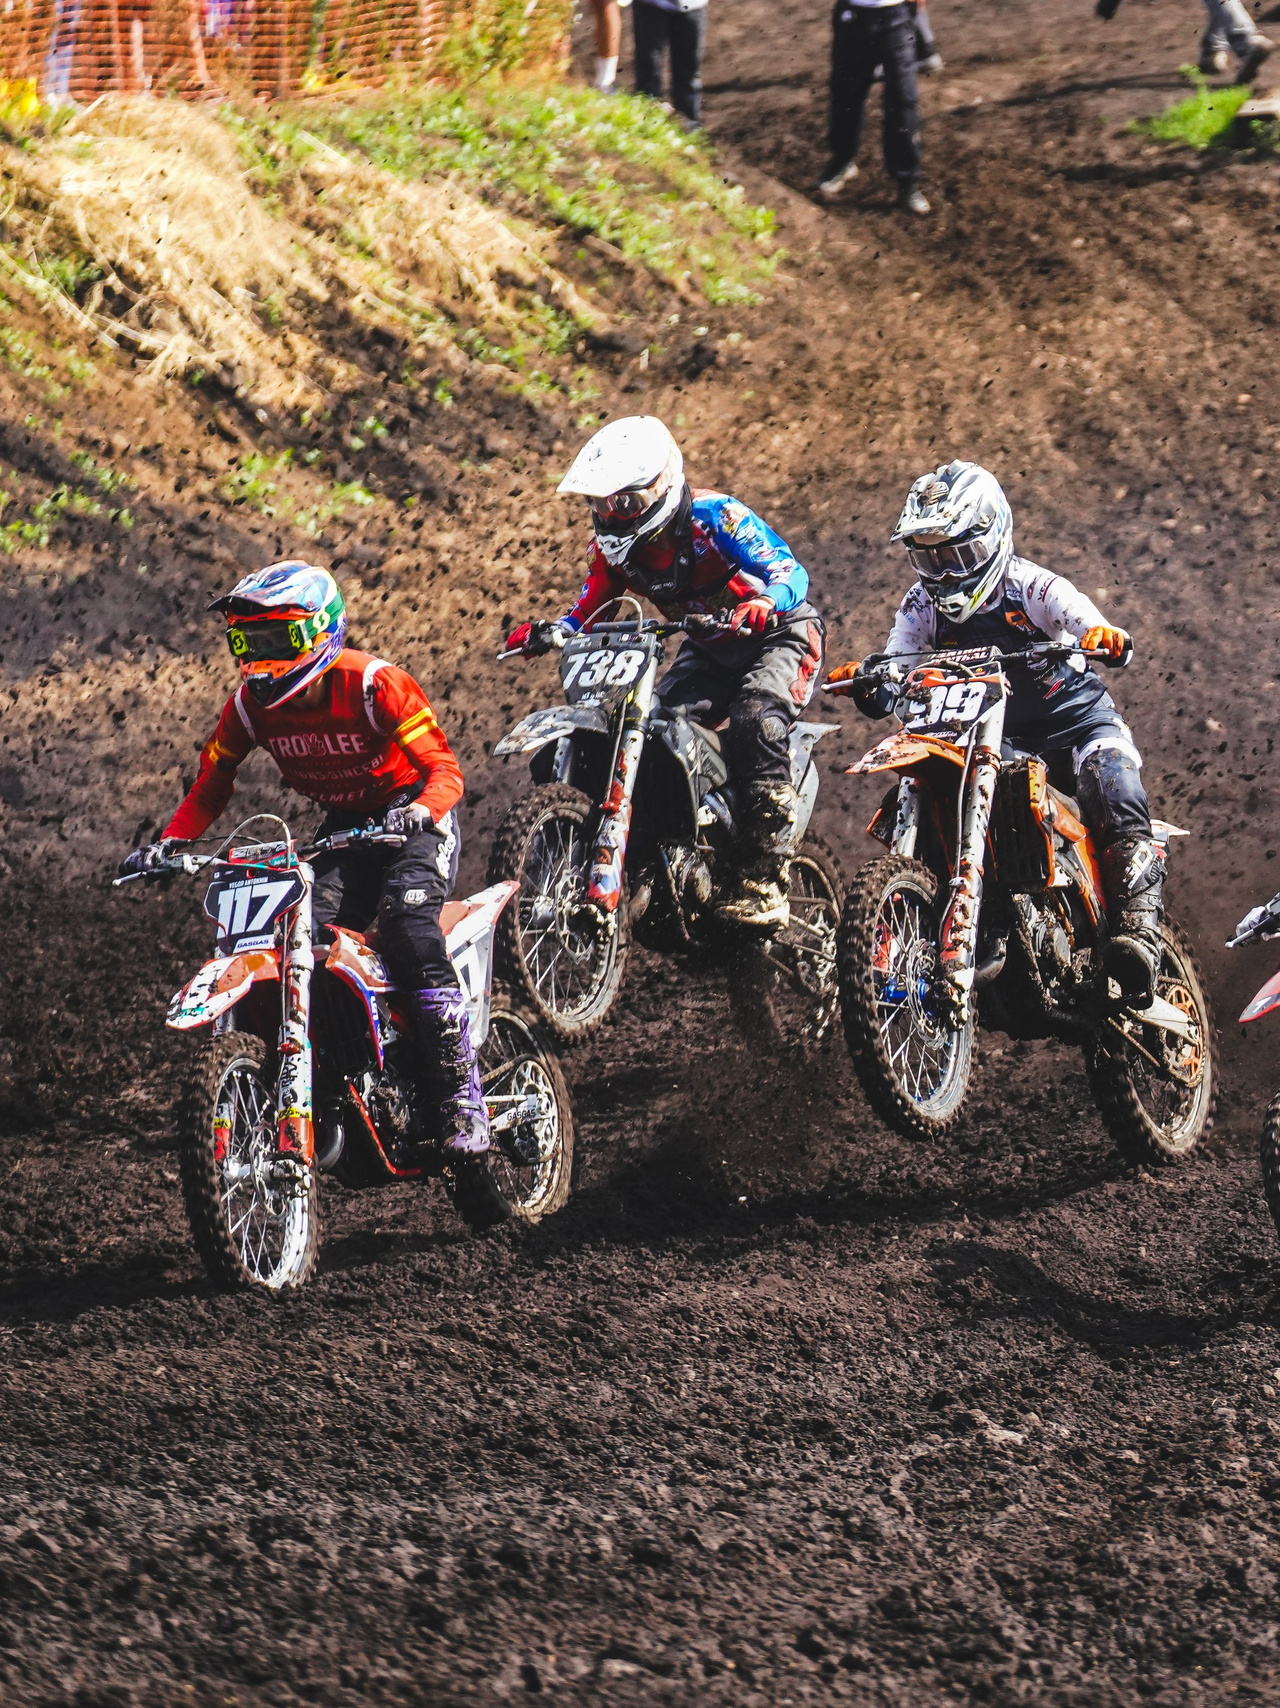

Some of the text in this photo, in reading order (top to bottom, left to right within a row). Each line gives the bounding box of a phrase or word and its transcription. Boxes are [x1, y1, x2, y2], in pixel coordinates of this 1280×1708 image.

[563, 649, 645, 691] 738
[905, 681, 987, 730] 99
[216, 880, 297, 940] 117
[237, 939, 269, 949] GASGAS
[507, 1108, 536, 1122] GASGAS
